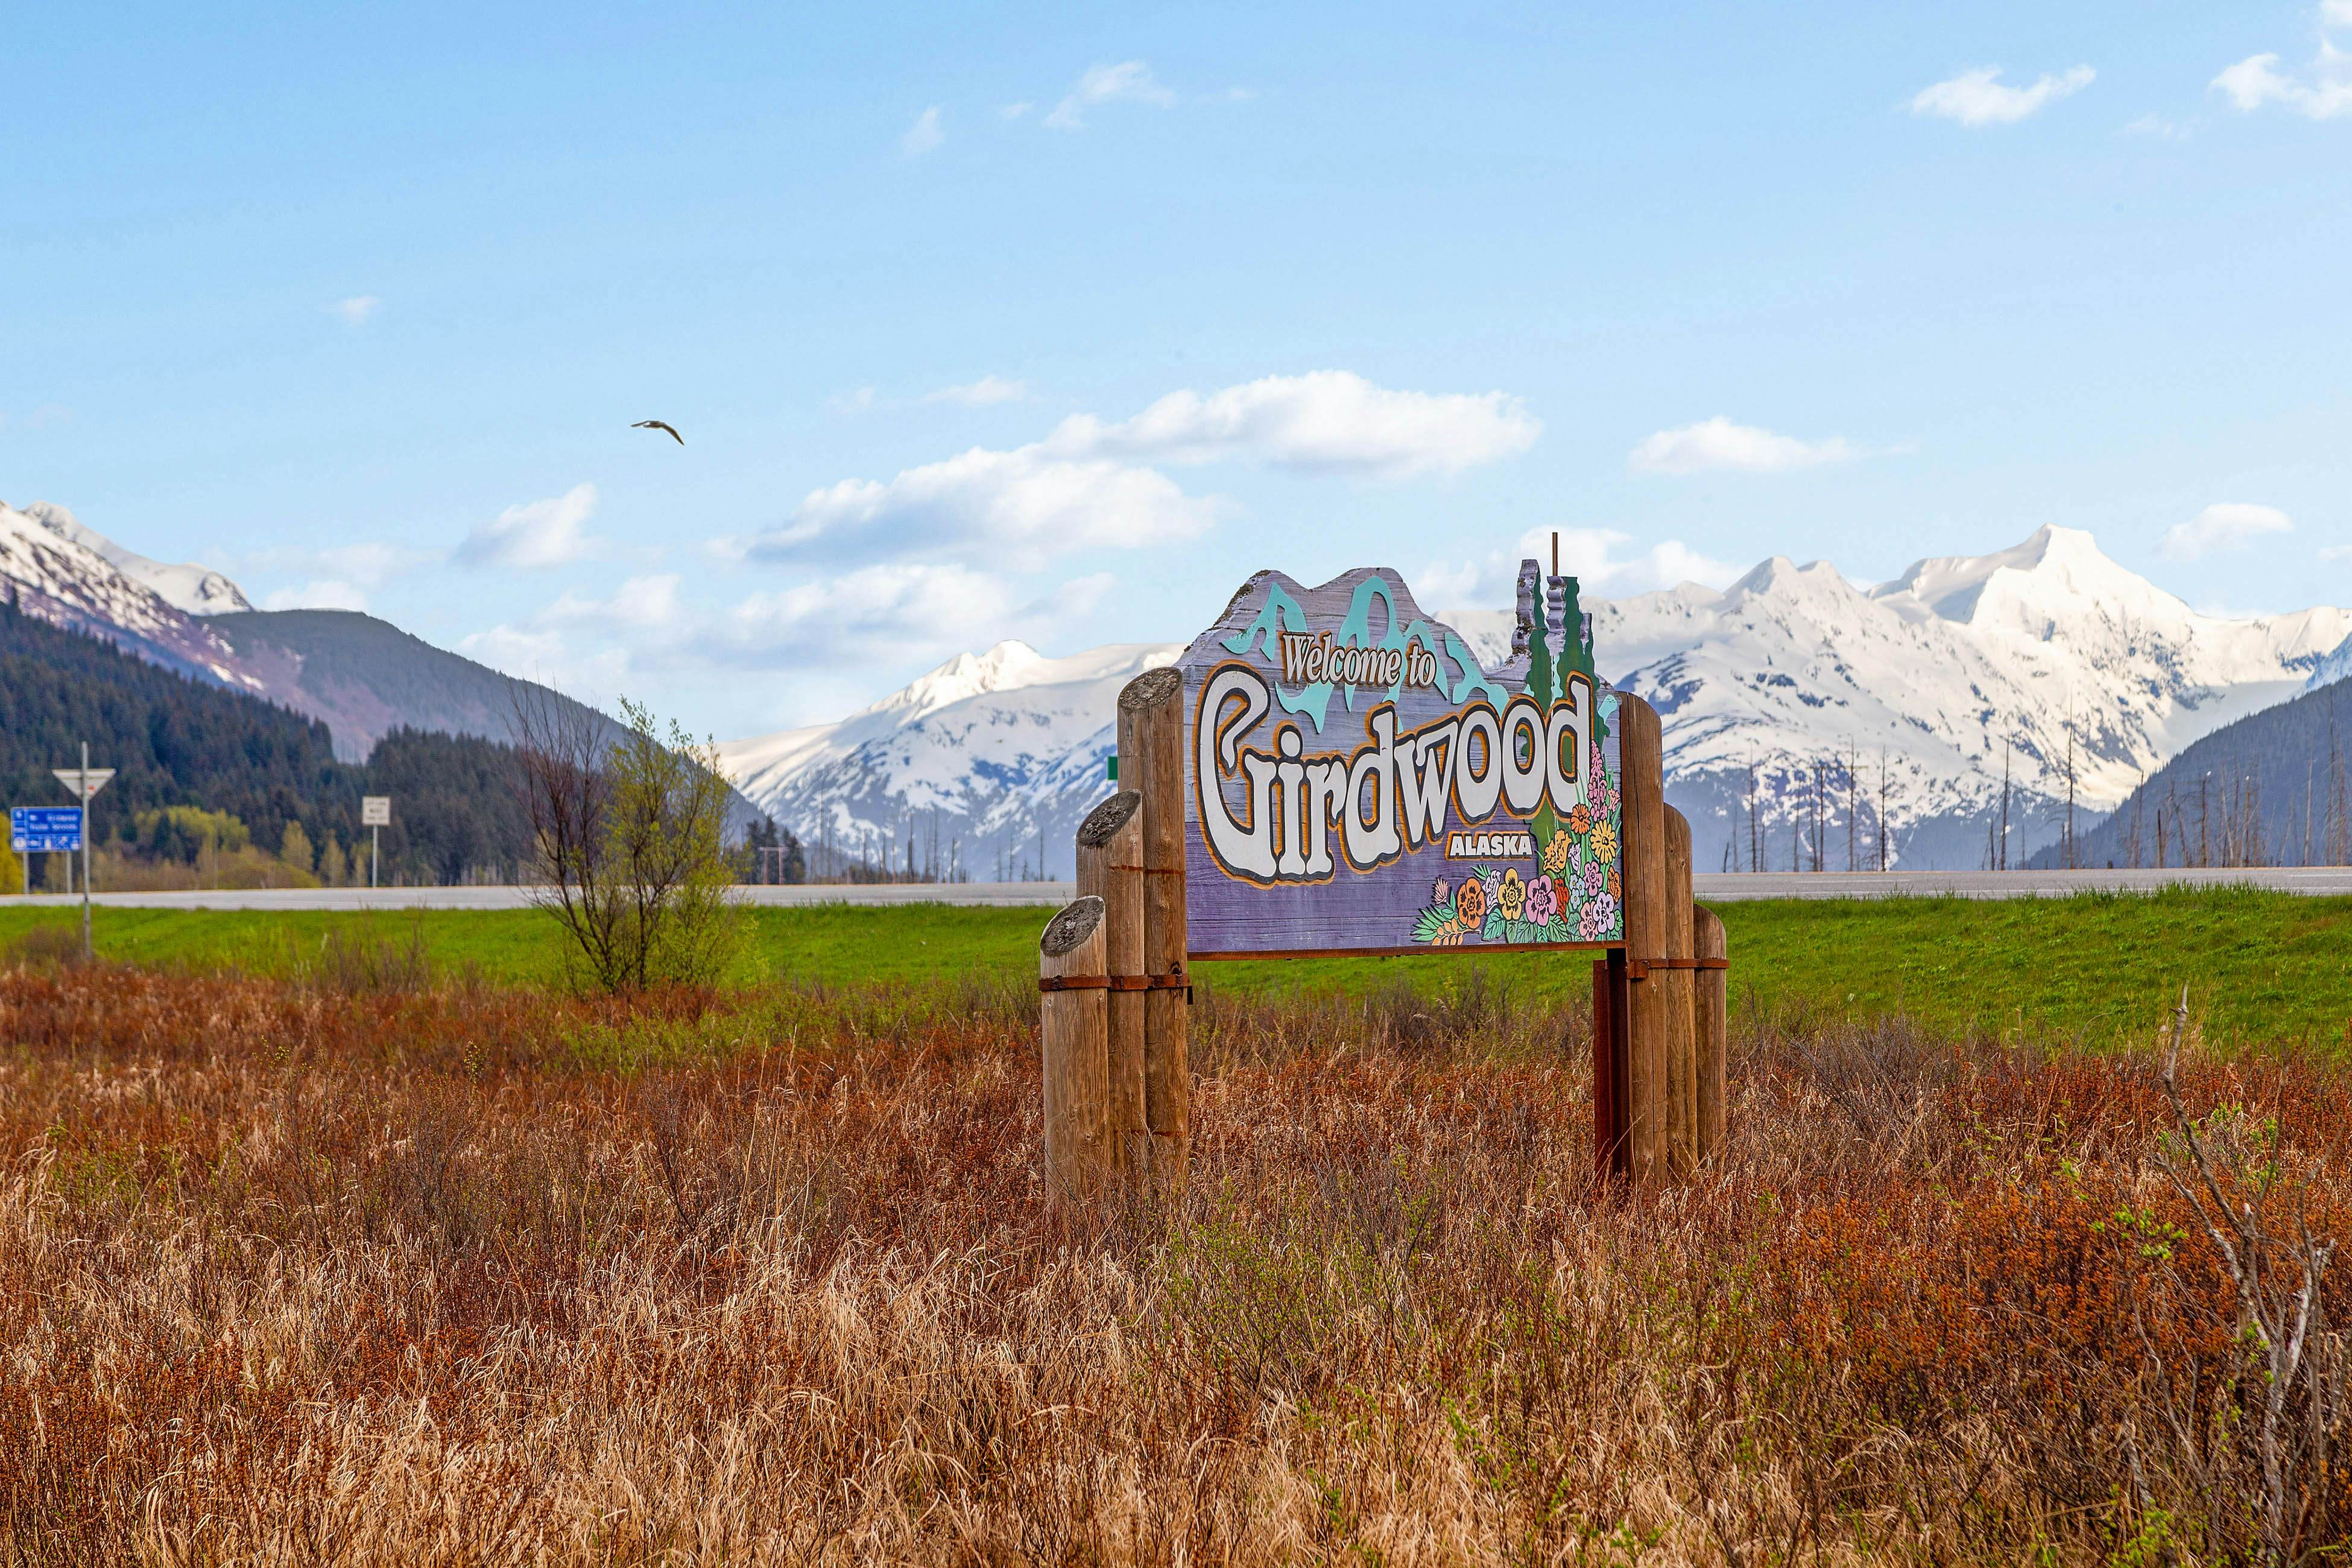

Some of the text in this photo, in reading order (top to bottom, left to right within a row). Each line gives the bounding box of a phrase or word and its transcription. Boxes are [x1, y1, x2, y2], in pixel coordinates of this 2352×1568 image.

[1283, 633, 1437, 687] Welcome to
[1198, 664, 1593, 881] Girdwood
[1449, 832, 1534, 858] ALASKA
